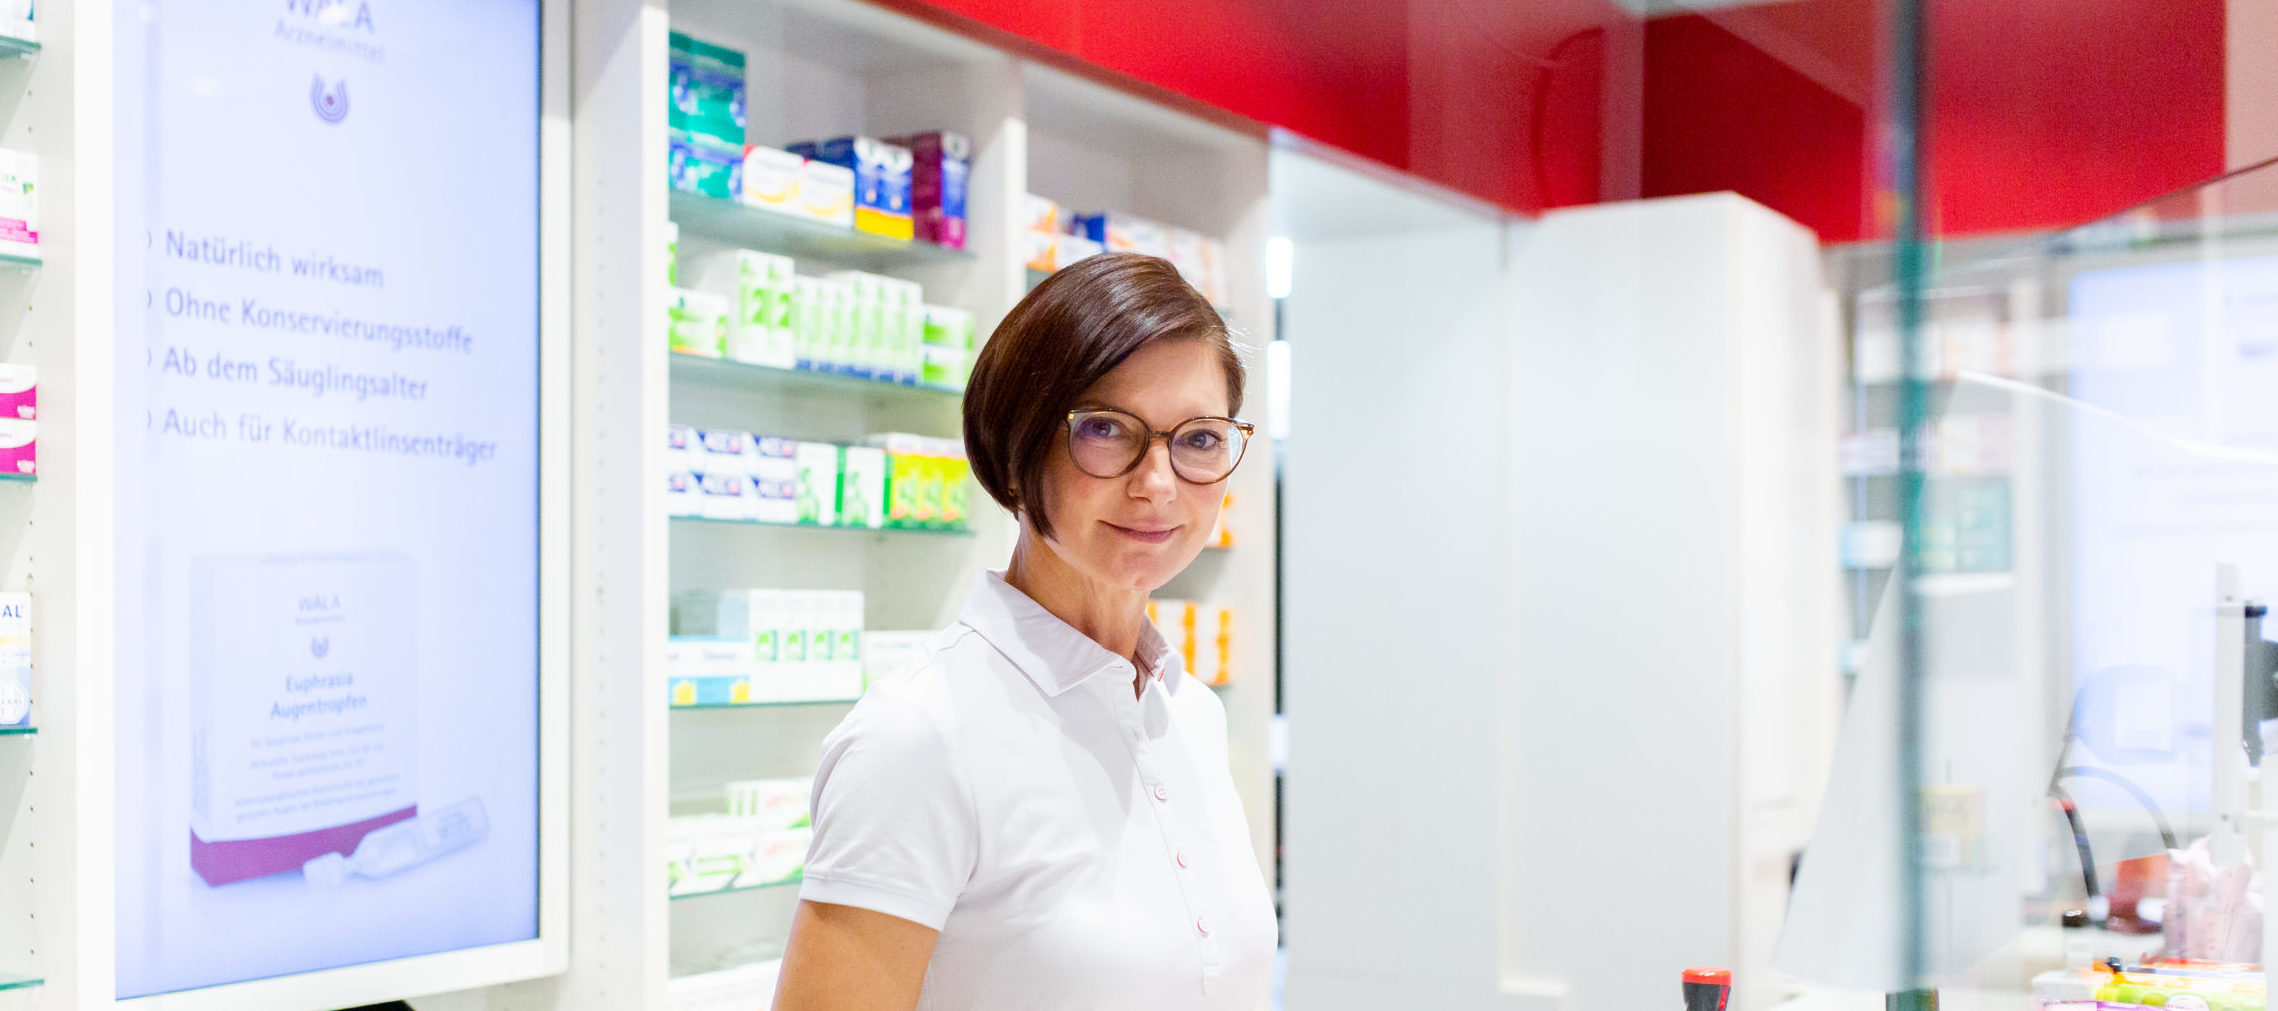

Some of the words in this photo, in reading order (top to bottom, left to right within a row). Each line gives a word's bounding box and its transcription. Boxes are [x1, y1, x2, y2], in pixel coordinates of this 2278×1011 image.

[166, 229, 281, 273] Natürlich
[291, 252, 385, 289] wirksam
[165, 287, 231, 325] Ohne
[240, 298, 474, 355] Konservierungsstoffe
[162, 346, 197, 377] Ab
[207, 351, 258, 383] dem
[268, 356, 429, 401] Säuglingsalter
[162, 407, 227, 439] Auch
[239, 412, 272, 443] für
[282, 418, 497, 466] Kontaktlinsenträger
[298, 594, 341, 611] WALA
[270, 695, 368, 720] Augentropfen
[285, 672, 354, 695] Euphrasia
